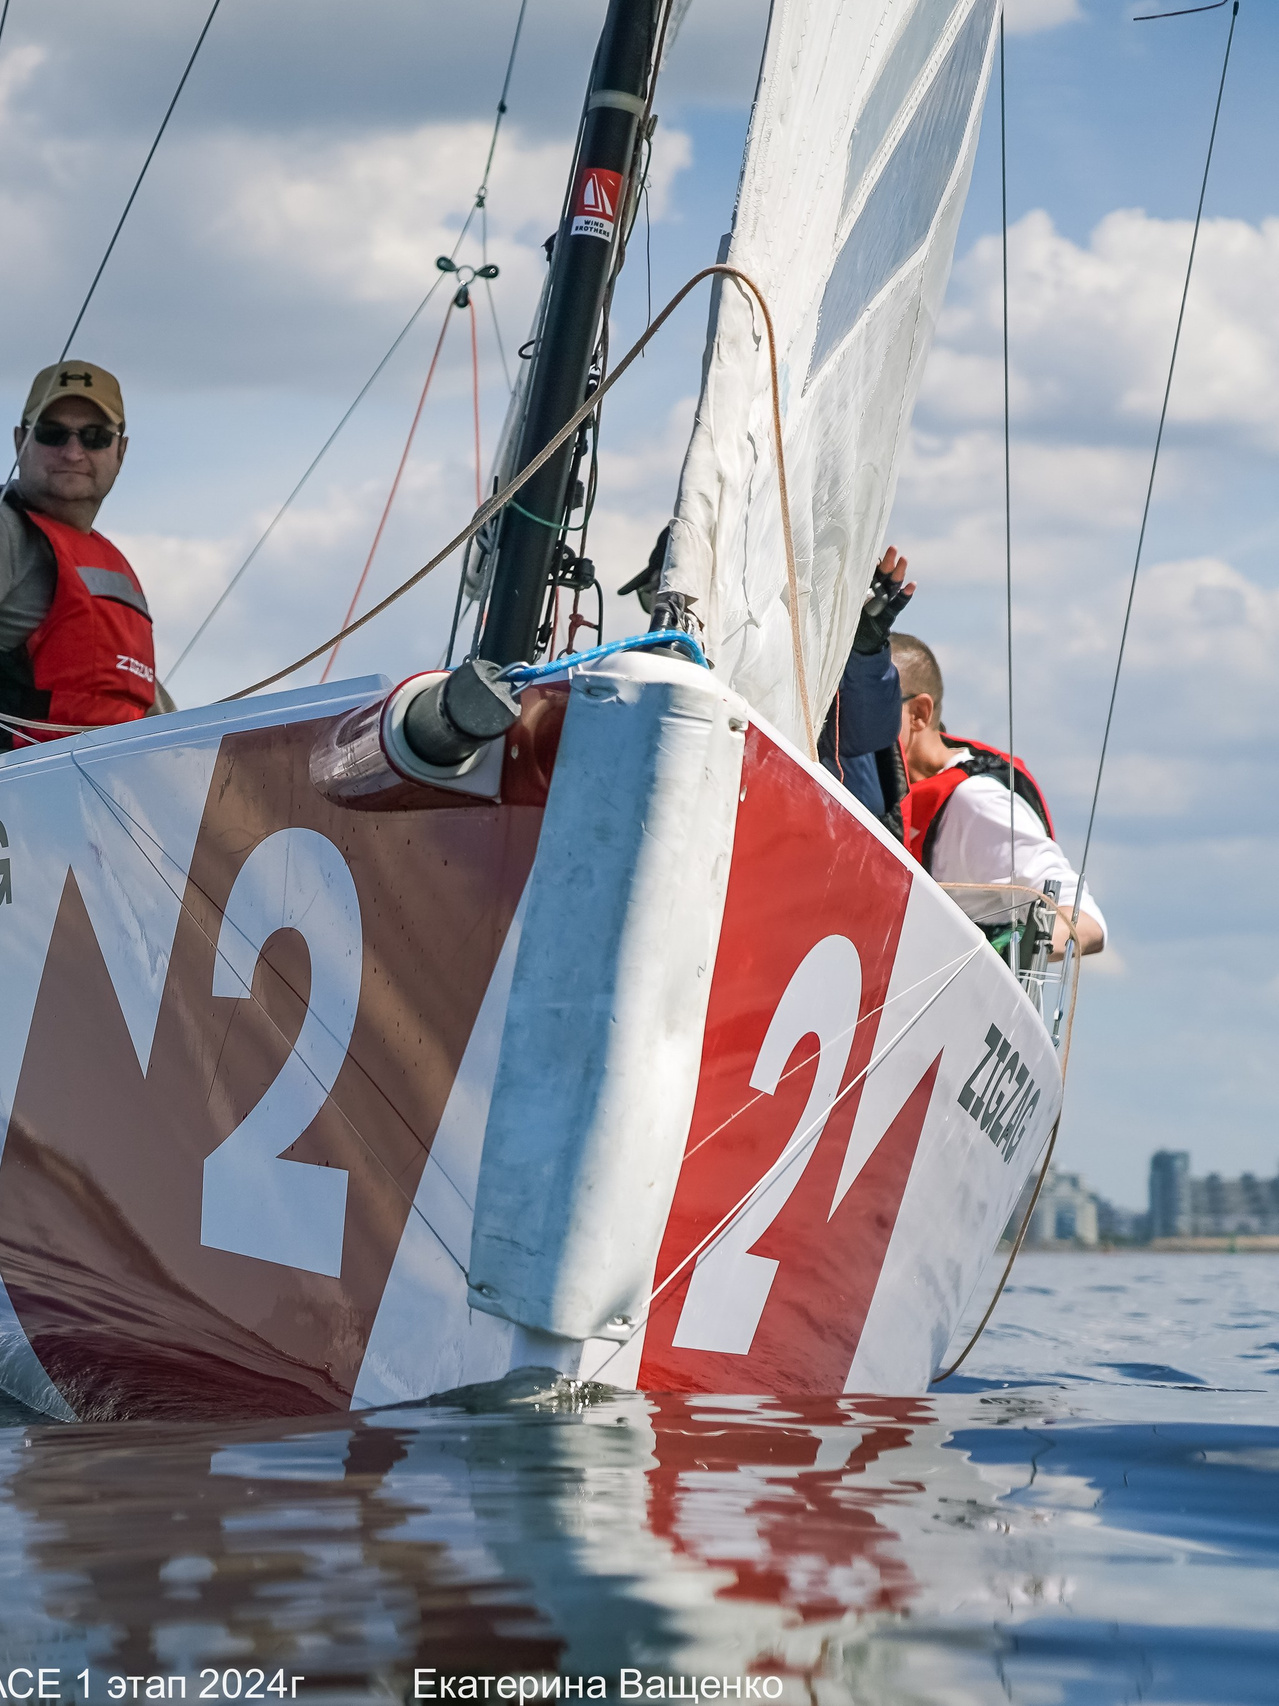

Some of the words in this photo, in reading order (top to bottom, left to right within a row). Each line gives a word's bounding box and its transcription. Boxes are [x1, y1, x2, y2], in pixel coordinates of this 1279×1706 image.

[574, 225, 610, 237] BROTHERS
[583, 219, 604, 227] WIND
[200, 827, 363, 1279] 2
[956, 1022, 1041, 1165] ZIGZAG
[671, 934, 863, 1356] 2
